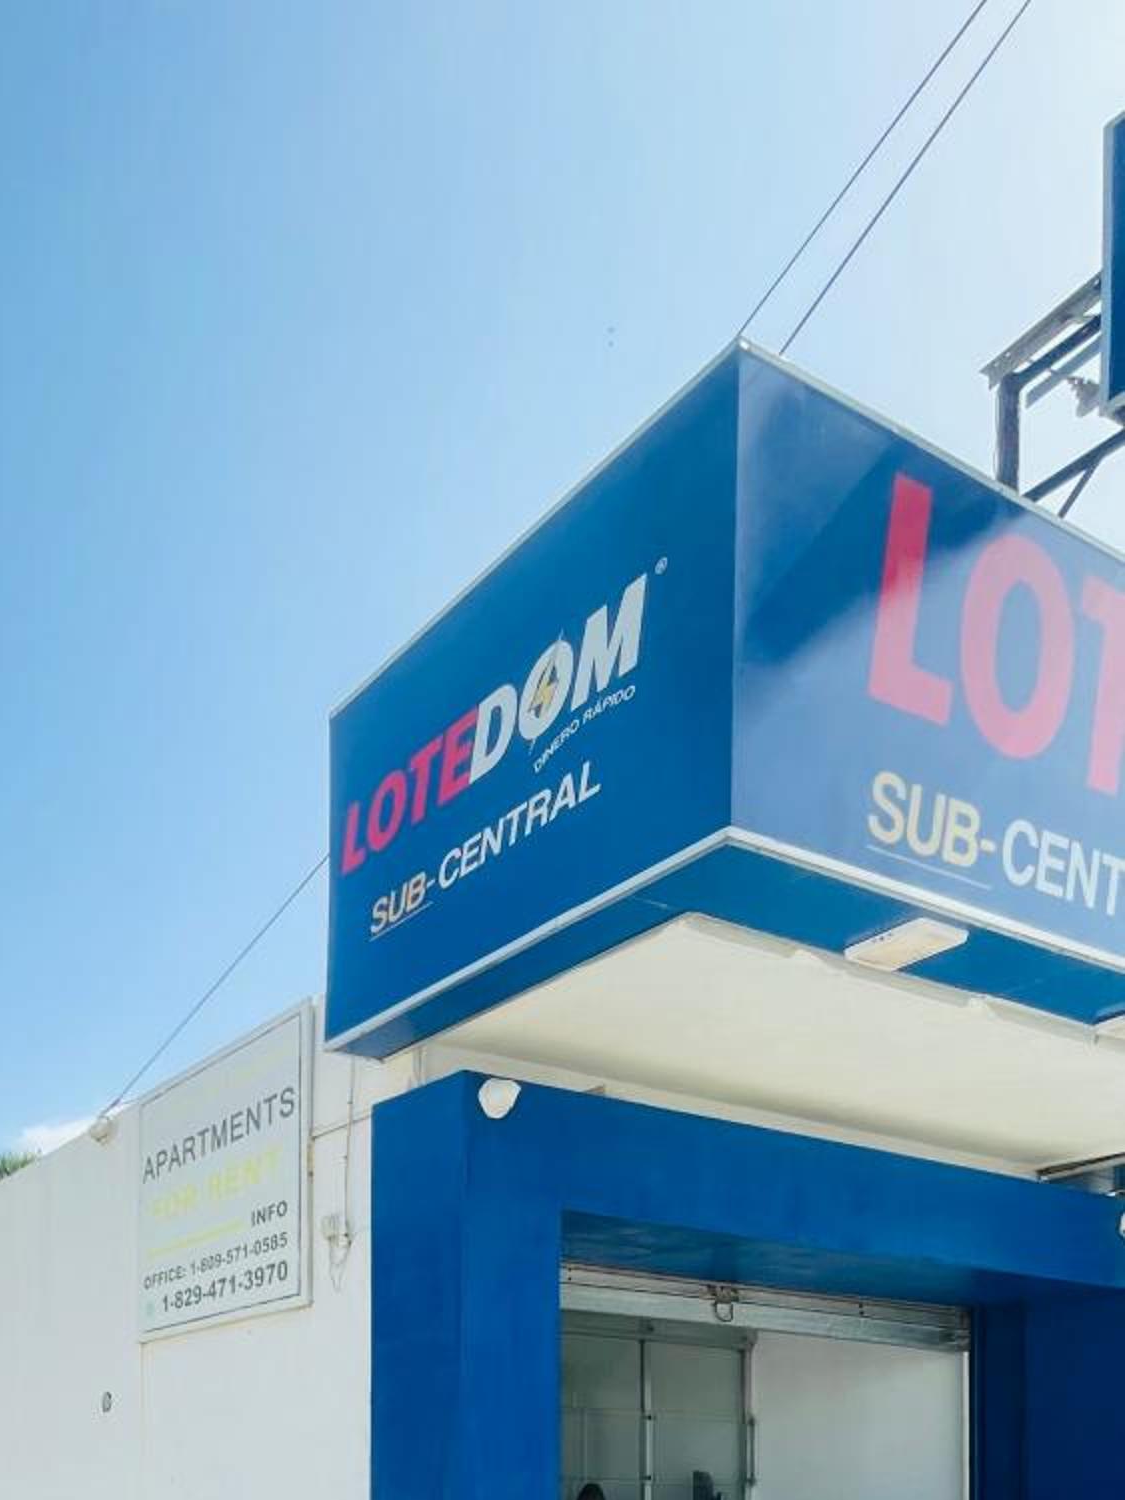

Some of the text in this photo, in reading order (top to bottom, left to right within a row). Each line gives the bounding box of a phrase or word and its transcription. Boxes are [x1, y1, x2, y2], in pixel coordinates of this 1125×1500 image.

[341, 573, 647, 875] LOTEDOM
[534, 719, 579, 773] DINERO
[370, 761, 601, 935] SUB-CENTRAL
[868, 771, 1125, 916] SUB-CENT
[143, 1087, 295, 1184] APARTMENTS
[251, 1200, 288, 1227] INFO
[143, 1265, 187, 1289] OFFICE:
[163, 1260, 288, 1312] 1-829-471-3970
